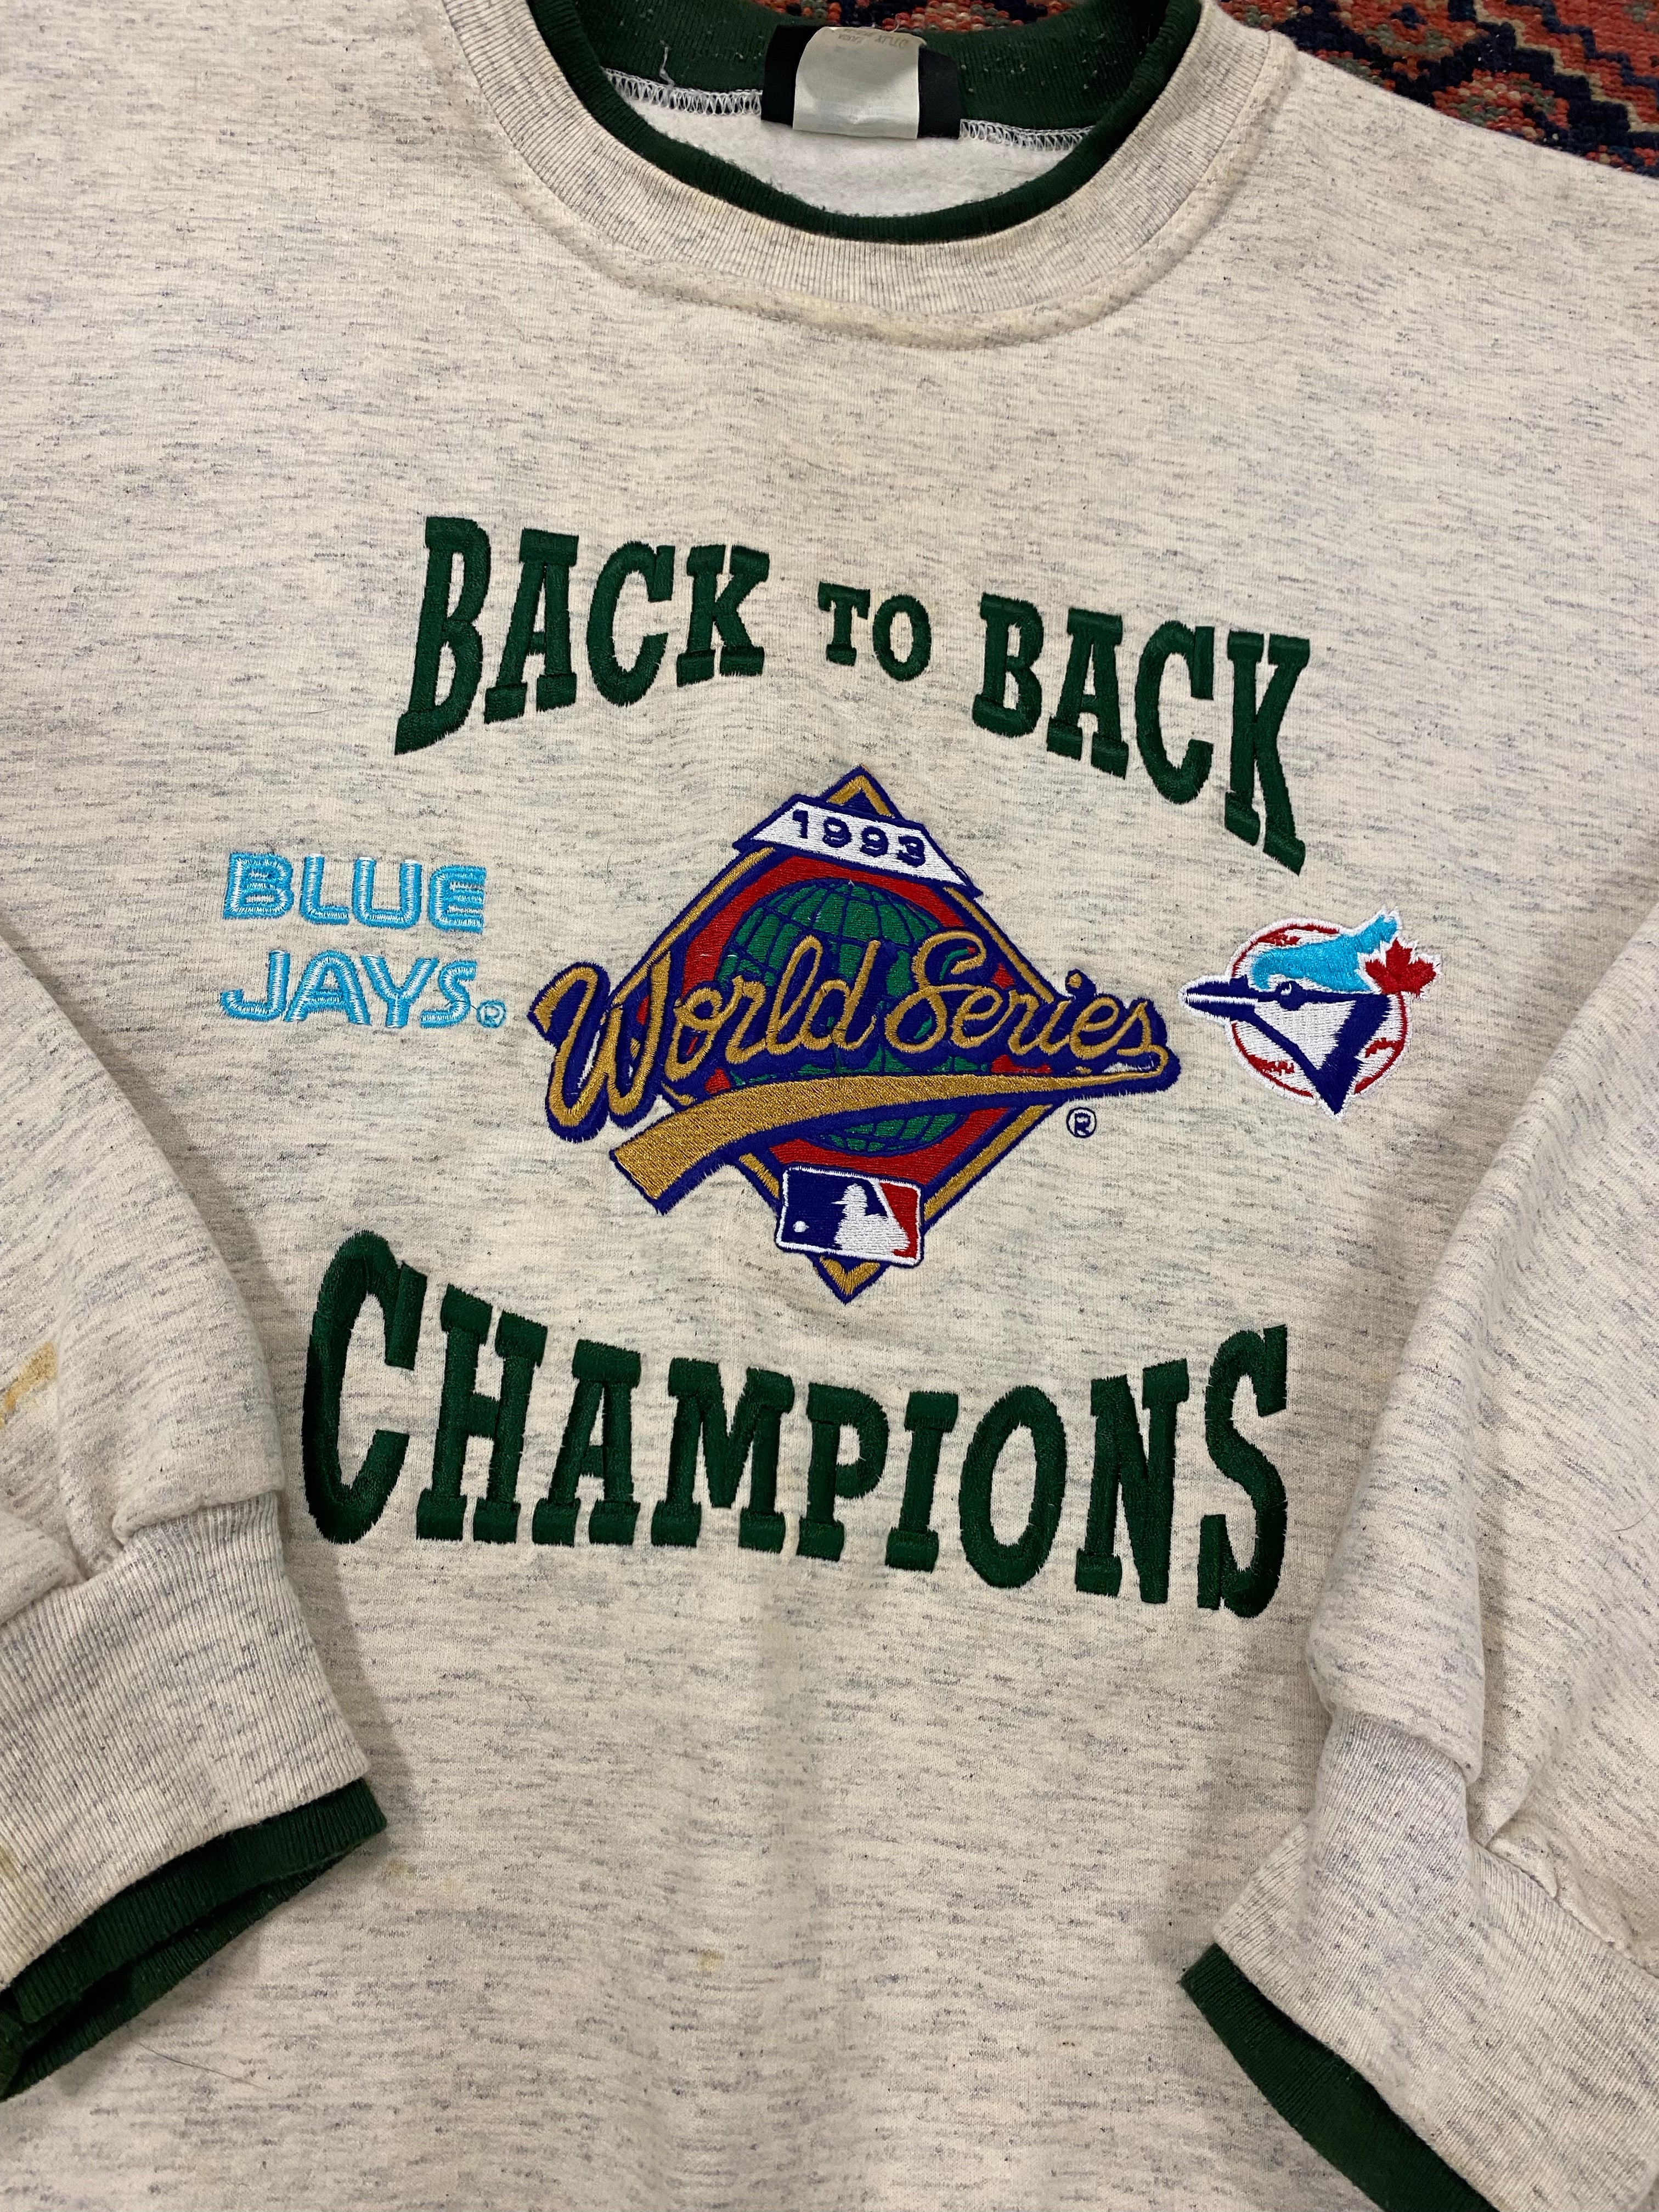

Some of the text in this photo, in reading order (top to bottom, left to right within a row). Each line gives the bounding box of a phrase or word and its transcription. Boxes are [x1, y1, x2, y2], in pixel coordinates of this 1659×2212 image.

[394, 516, 1310, 876] BACK TO BACK
[223, 851, 487, 934] BLUE
[793, 809, 926, 867] 1993
[534, 930, 1168, 1127] World Series
[302, 1230, 1288, 1618] CHAMPIONS
